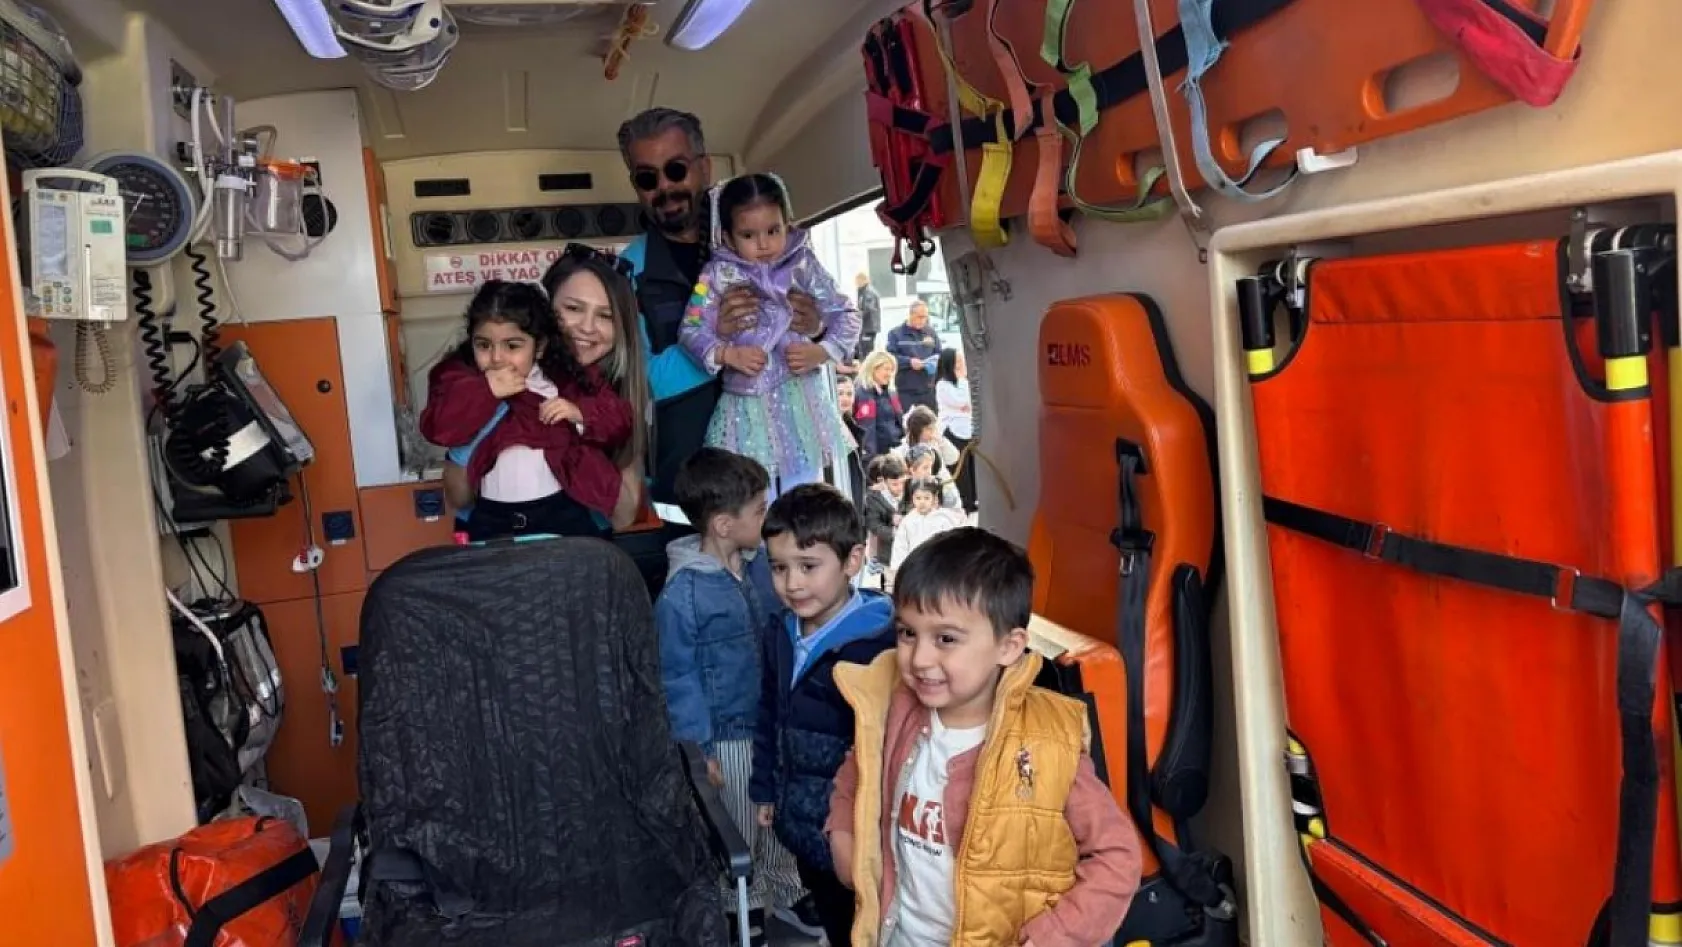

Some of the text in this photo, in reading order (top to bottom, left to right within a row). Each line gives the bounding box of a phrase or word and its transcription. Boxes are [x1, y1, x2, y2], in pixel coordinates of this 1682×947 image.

[479, 250, 539, 266] DİKKAT
[434, 265, 540, 285] ATEŞ VE YAĞ
